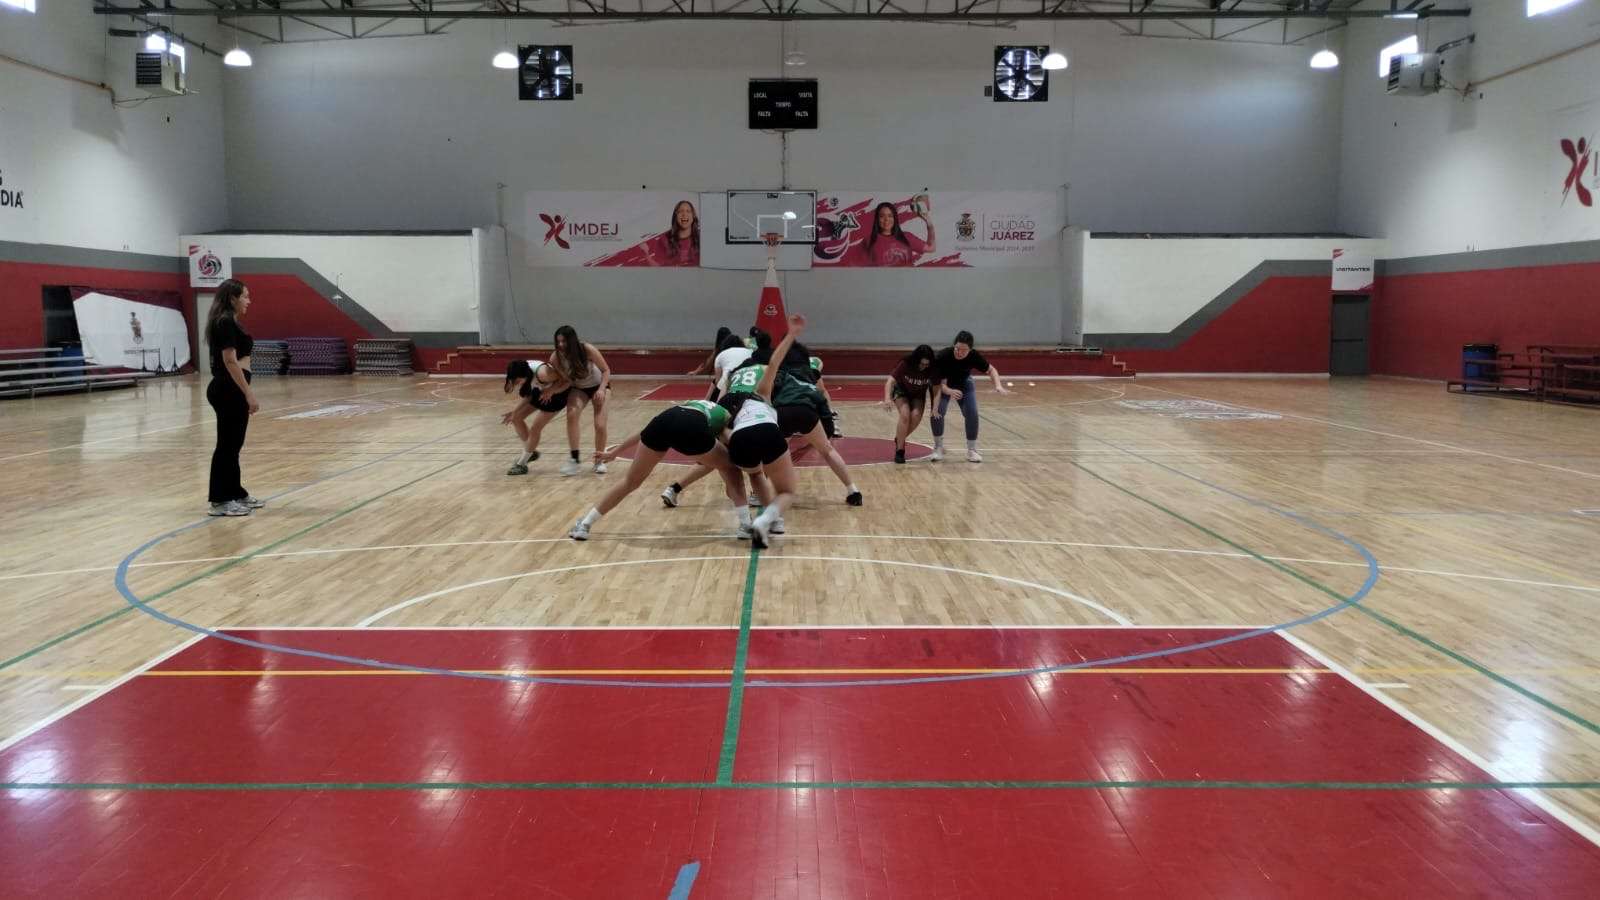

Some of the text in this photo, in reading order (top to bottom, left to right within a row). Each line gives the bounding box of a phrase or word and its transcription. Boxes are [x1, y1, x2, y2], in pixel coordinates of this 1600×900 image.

[569, 223, 619, 236] IMDEJ
[990, 220, 1035, 230] CIUDAD
[990, 230, 1034, 240] JUÁREZ
[730, 371, 756, 387] 28
